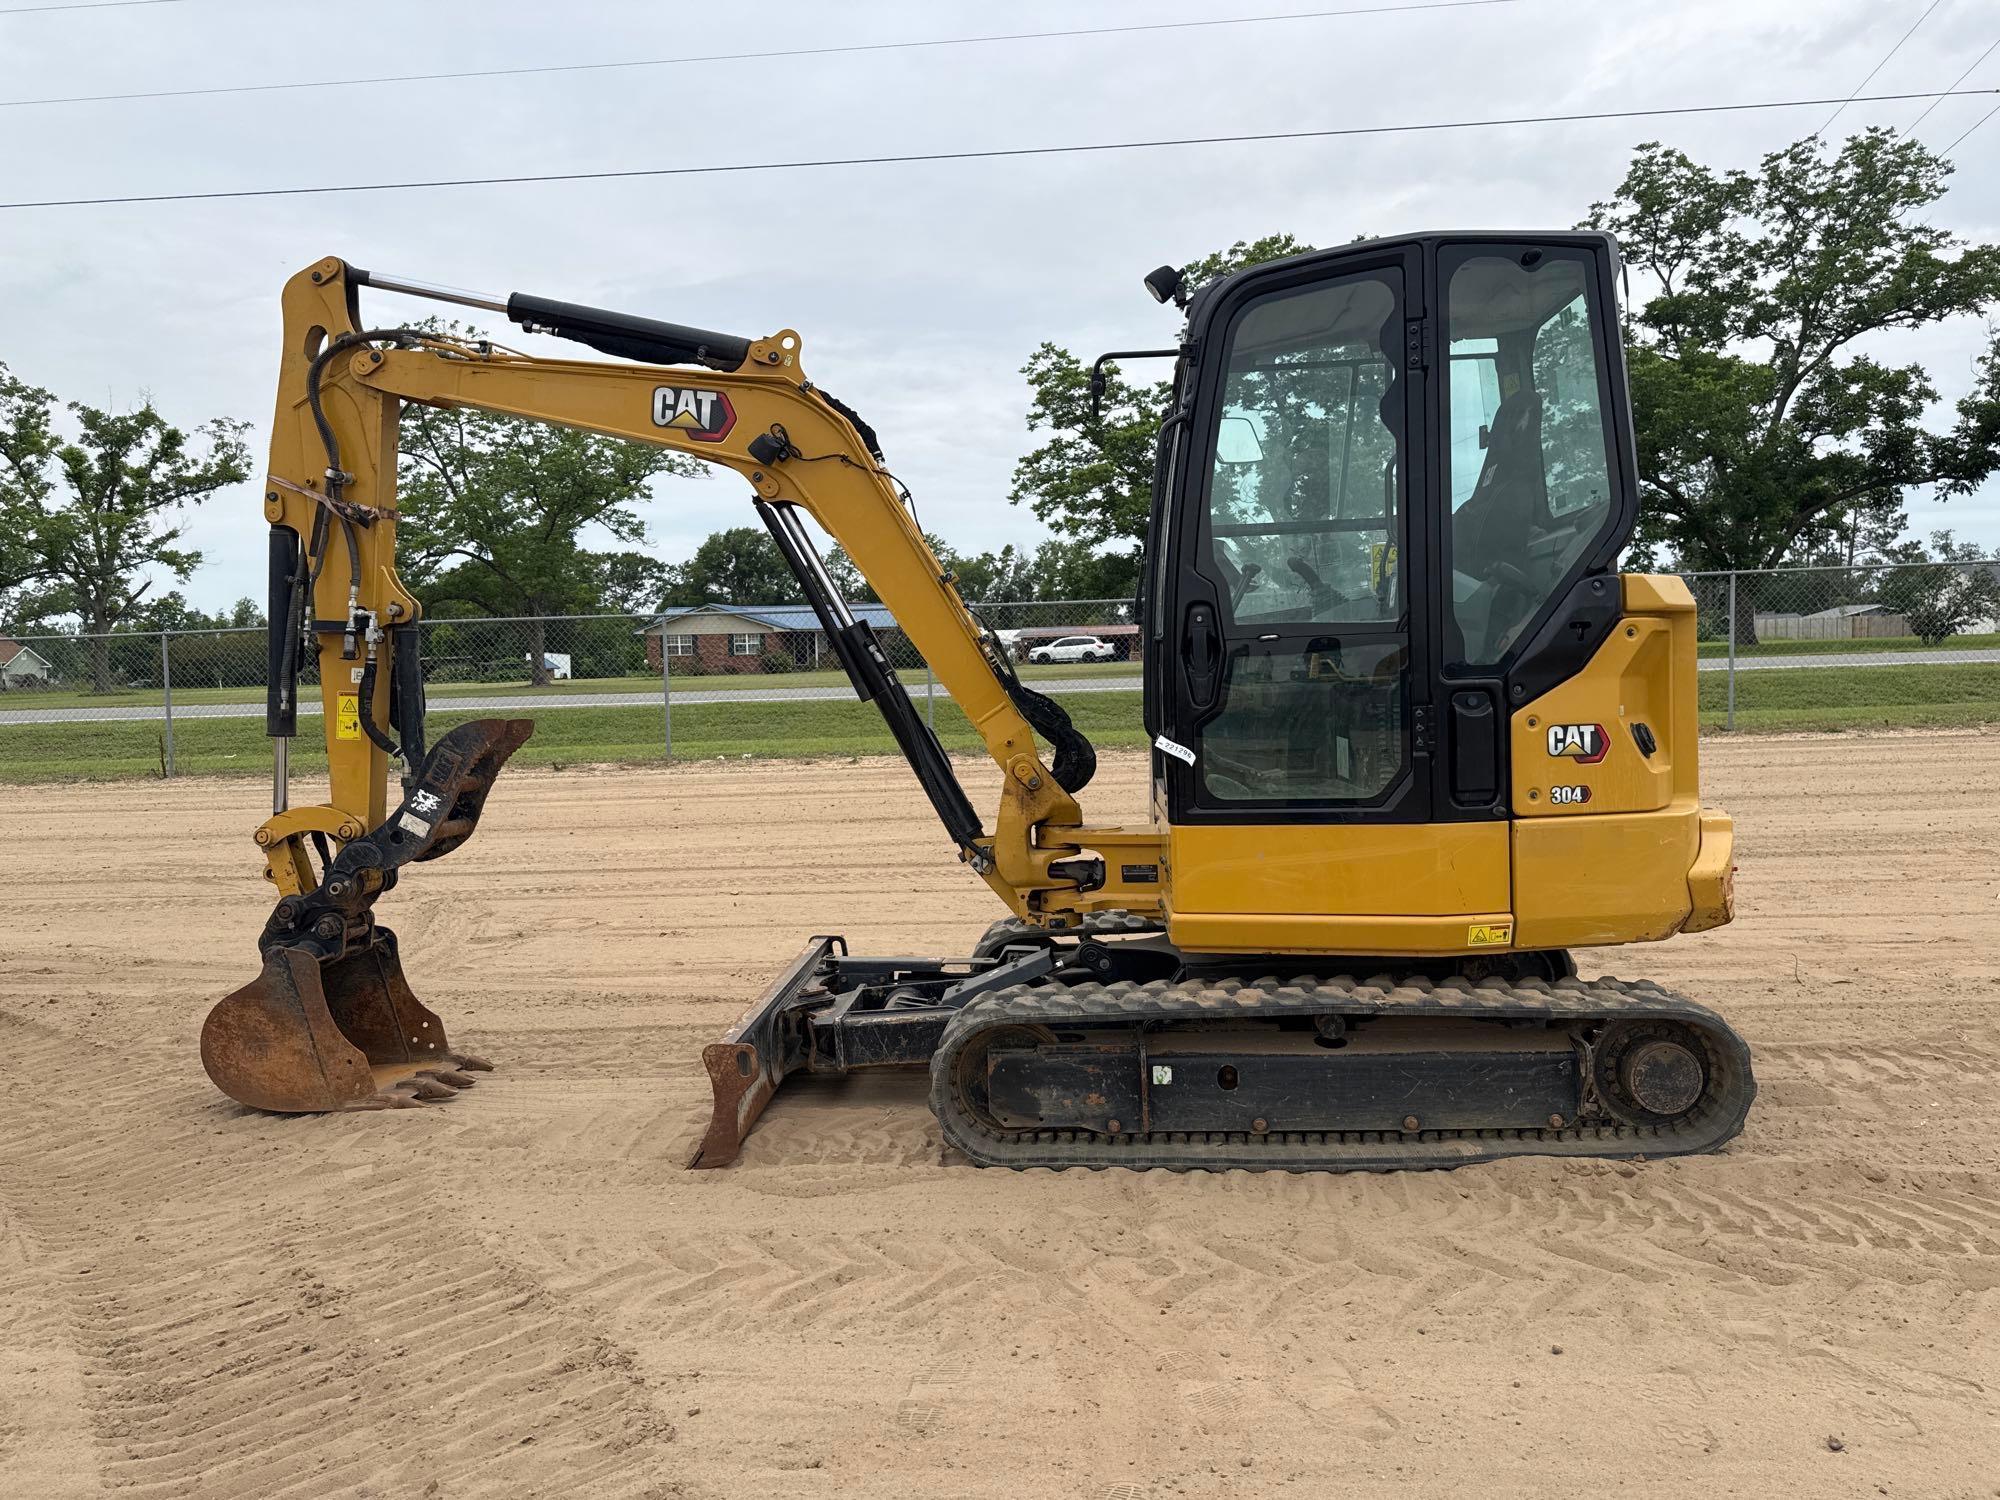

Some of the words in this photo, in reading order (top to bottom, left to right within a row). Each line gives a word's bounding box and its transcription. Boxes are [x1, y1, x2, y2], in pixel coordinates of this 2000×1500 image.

[653, 387, 717, 430] CAT
[1548, 725, 1595, 756] CAT
[1551, 786, 1582, 803] 304
